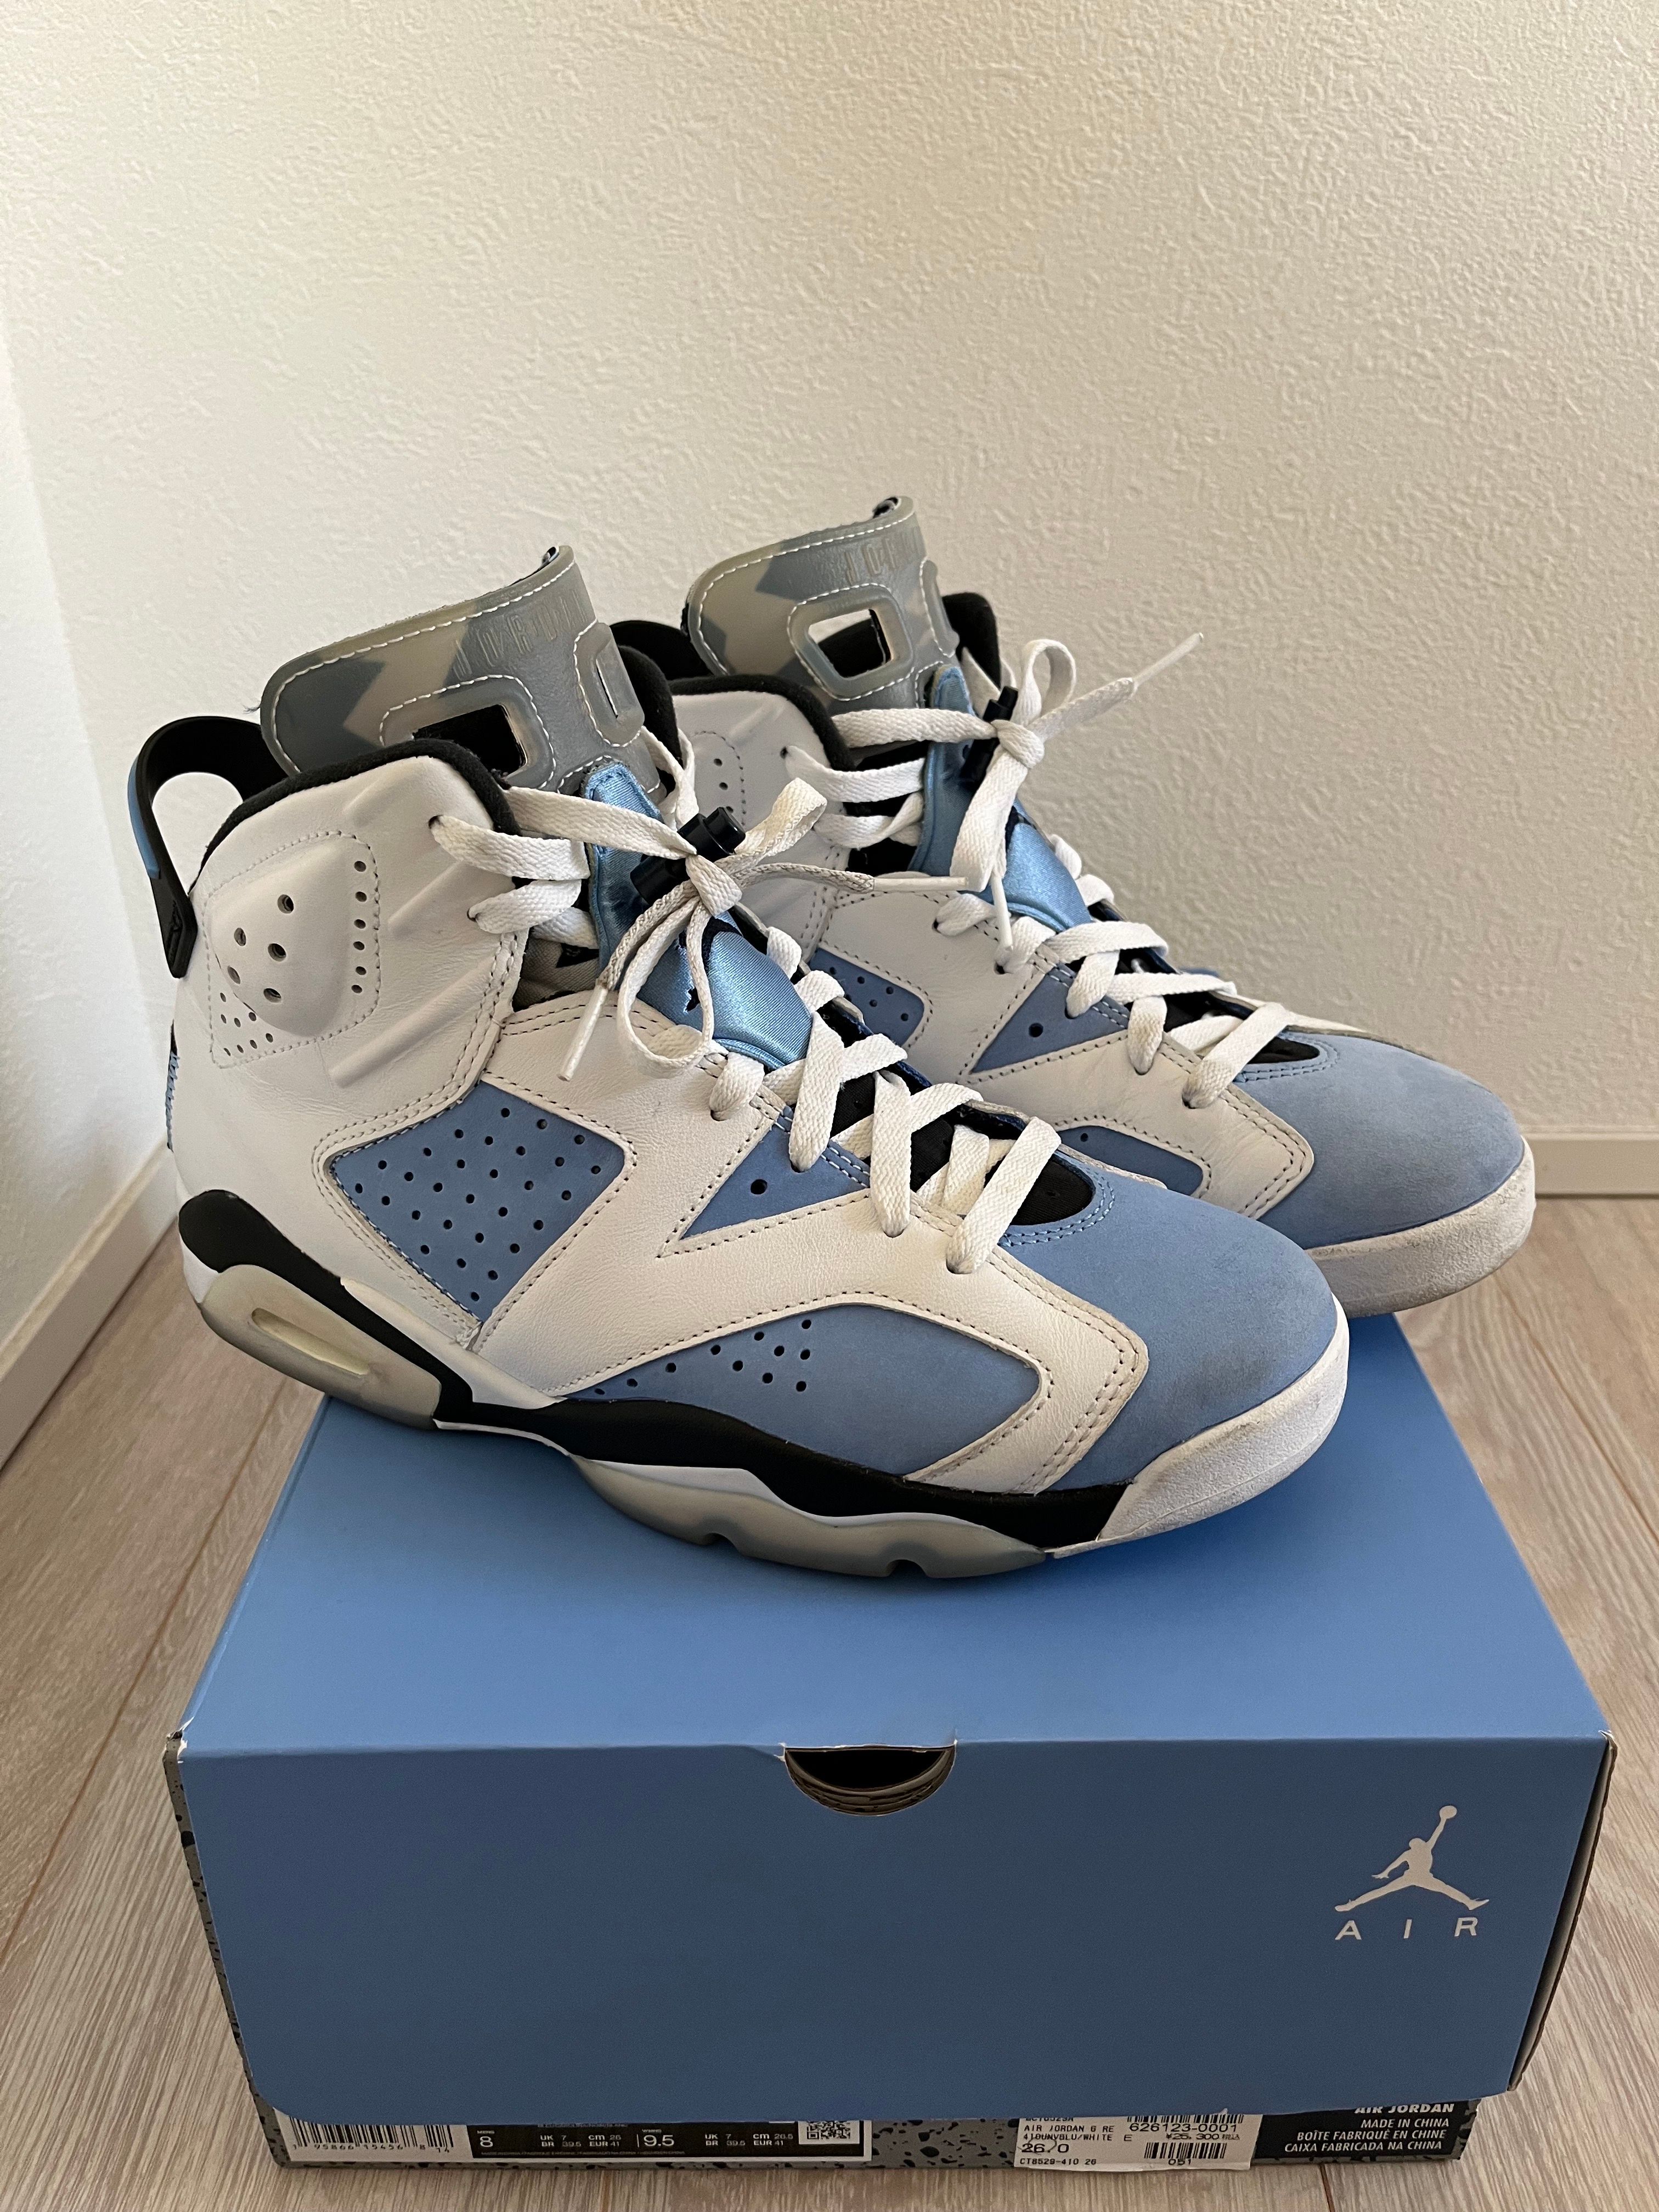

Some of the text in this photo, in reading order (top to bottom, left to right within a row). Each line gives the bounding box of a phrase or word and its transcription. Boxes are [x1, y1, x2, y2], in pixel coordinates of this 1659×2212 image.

[1335, 1917, 1478, 1940] AIR
[1355, 2103, 1455, 2114] AIR JORDAN
[1130, 2123, 1237, 2132] 626123-0001
[1361, 2118, 1449, 2128] MADE IN CHINA
[643, 2134, 675, 2147] 9.5
[1297, 2130, 1329, 2141] BOÎTE
[1392, 2130, 1408, 2139] EN
[1412, 2129, 1447, 2138] CHINE
[479, 2135, 494, 2148] 8
[1285, 2141, 1442, 2152] CAIXA FABRICADA NA CHINA
[1022, 2143, 1070, 2153] 26.0
